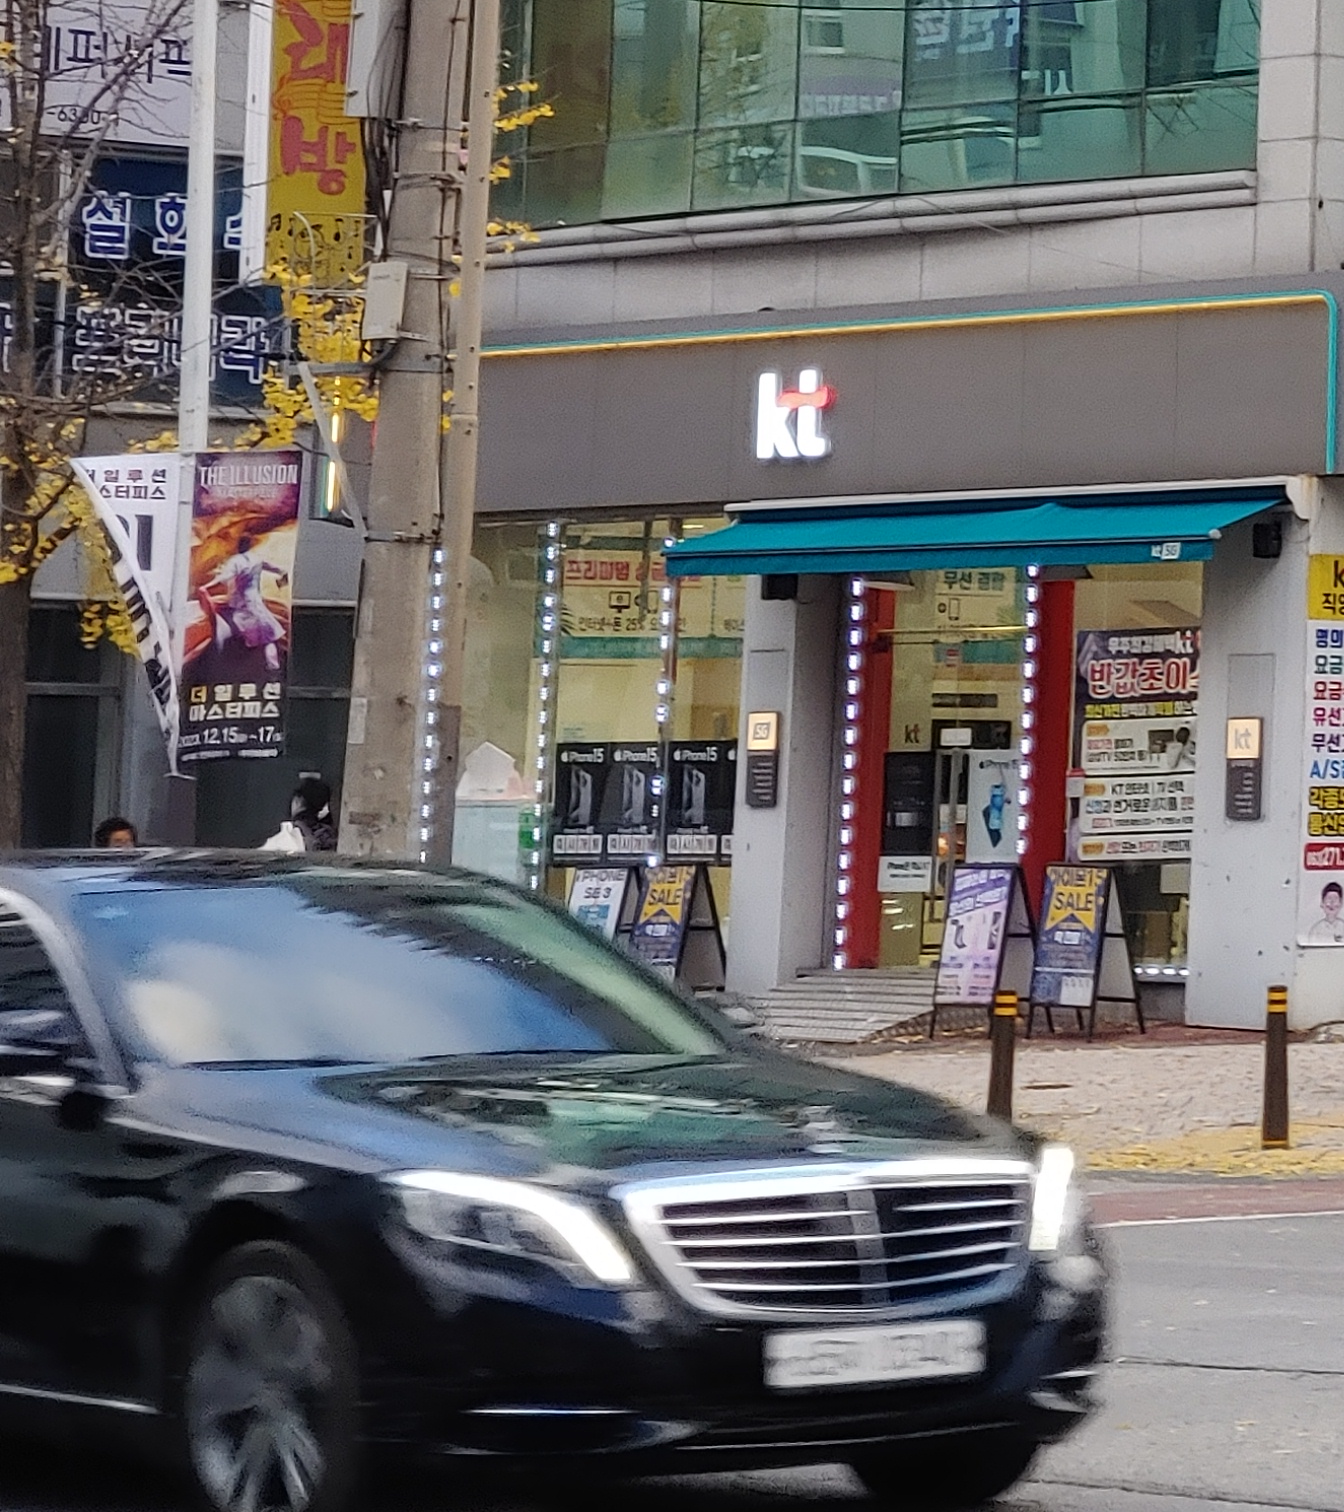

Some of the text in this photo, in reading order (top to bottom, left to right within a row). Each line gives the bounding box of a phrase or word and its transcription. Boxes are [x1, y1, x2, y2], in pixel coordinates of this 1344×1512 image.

[755, 368, 838, 460] kt
[200, 464, 299, 487] THE ILLUSION
[944, 570, 973, 591] 무선
[1088, 658, 1199, 698] 반값초이
[188, 700, 281, 722] 마스터피스
[904, 723, 921, 744] kt
[1234, 727, 1252, 751] kt
[647, 888, 683, 906] SALE
[1054, 890, 1097, 912] SALE
